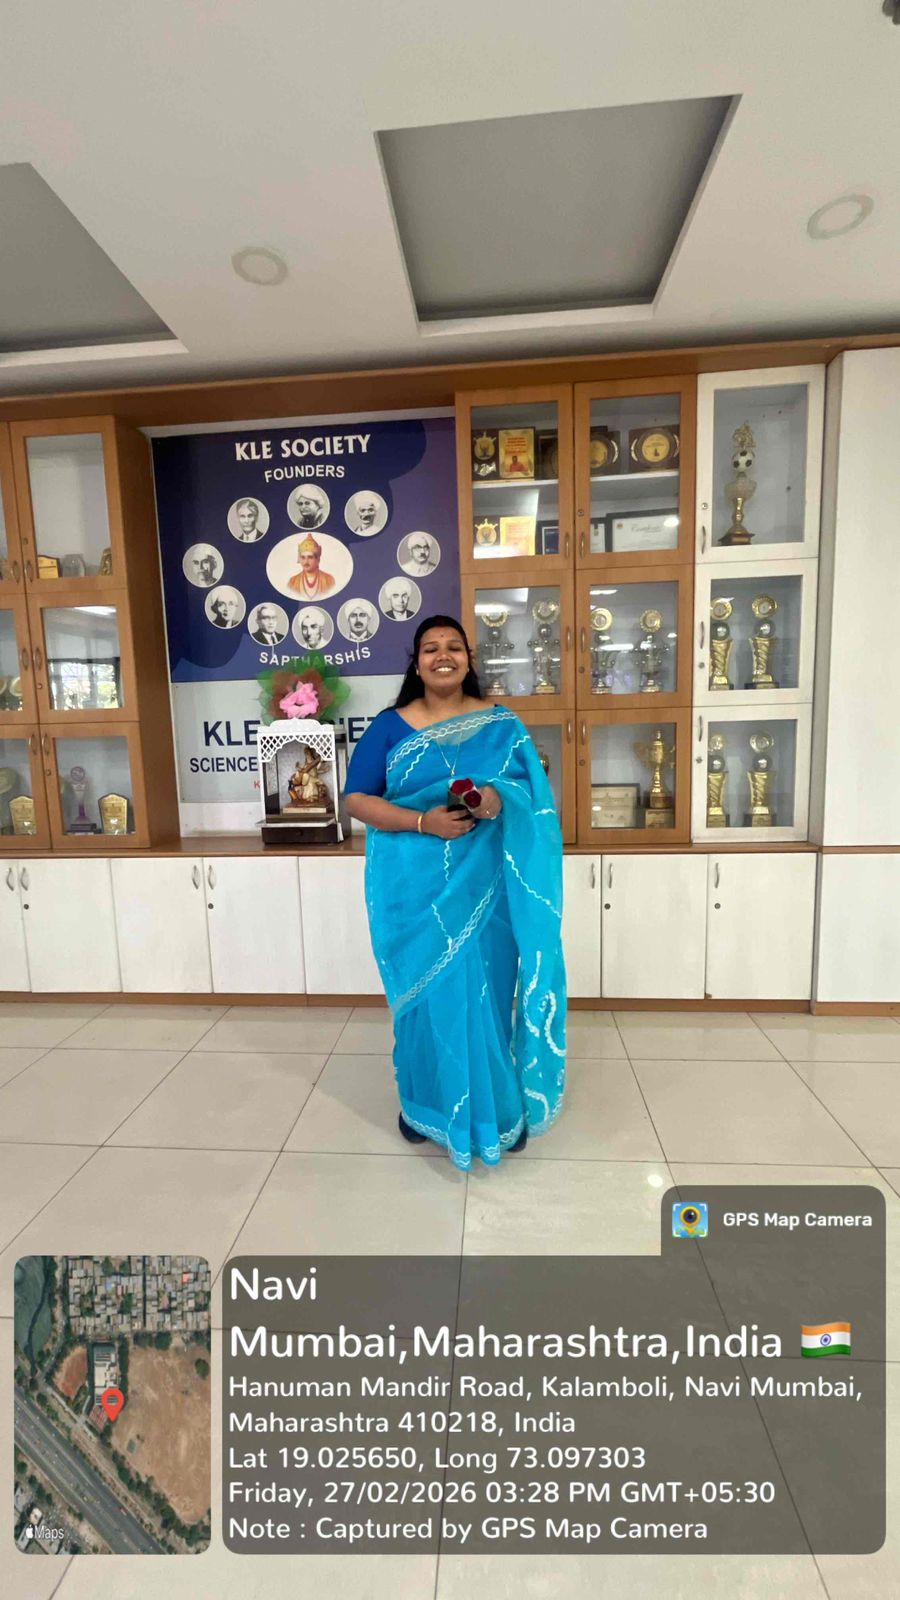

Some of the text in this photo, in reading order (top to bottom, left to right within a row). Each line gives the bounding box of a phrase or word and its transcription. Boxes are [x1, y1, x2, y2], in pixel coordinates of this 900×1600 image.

[235, 434, 370, 460] KLE SOCIETY
[264, 465, 345, 483] FOUNDERS
[259, 646, 371, 667] SAPTHARSHIS
[203, 720, 261, 747] KLE
[189, 757, 259, 773] SCIENCE
